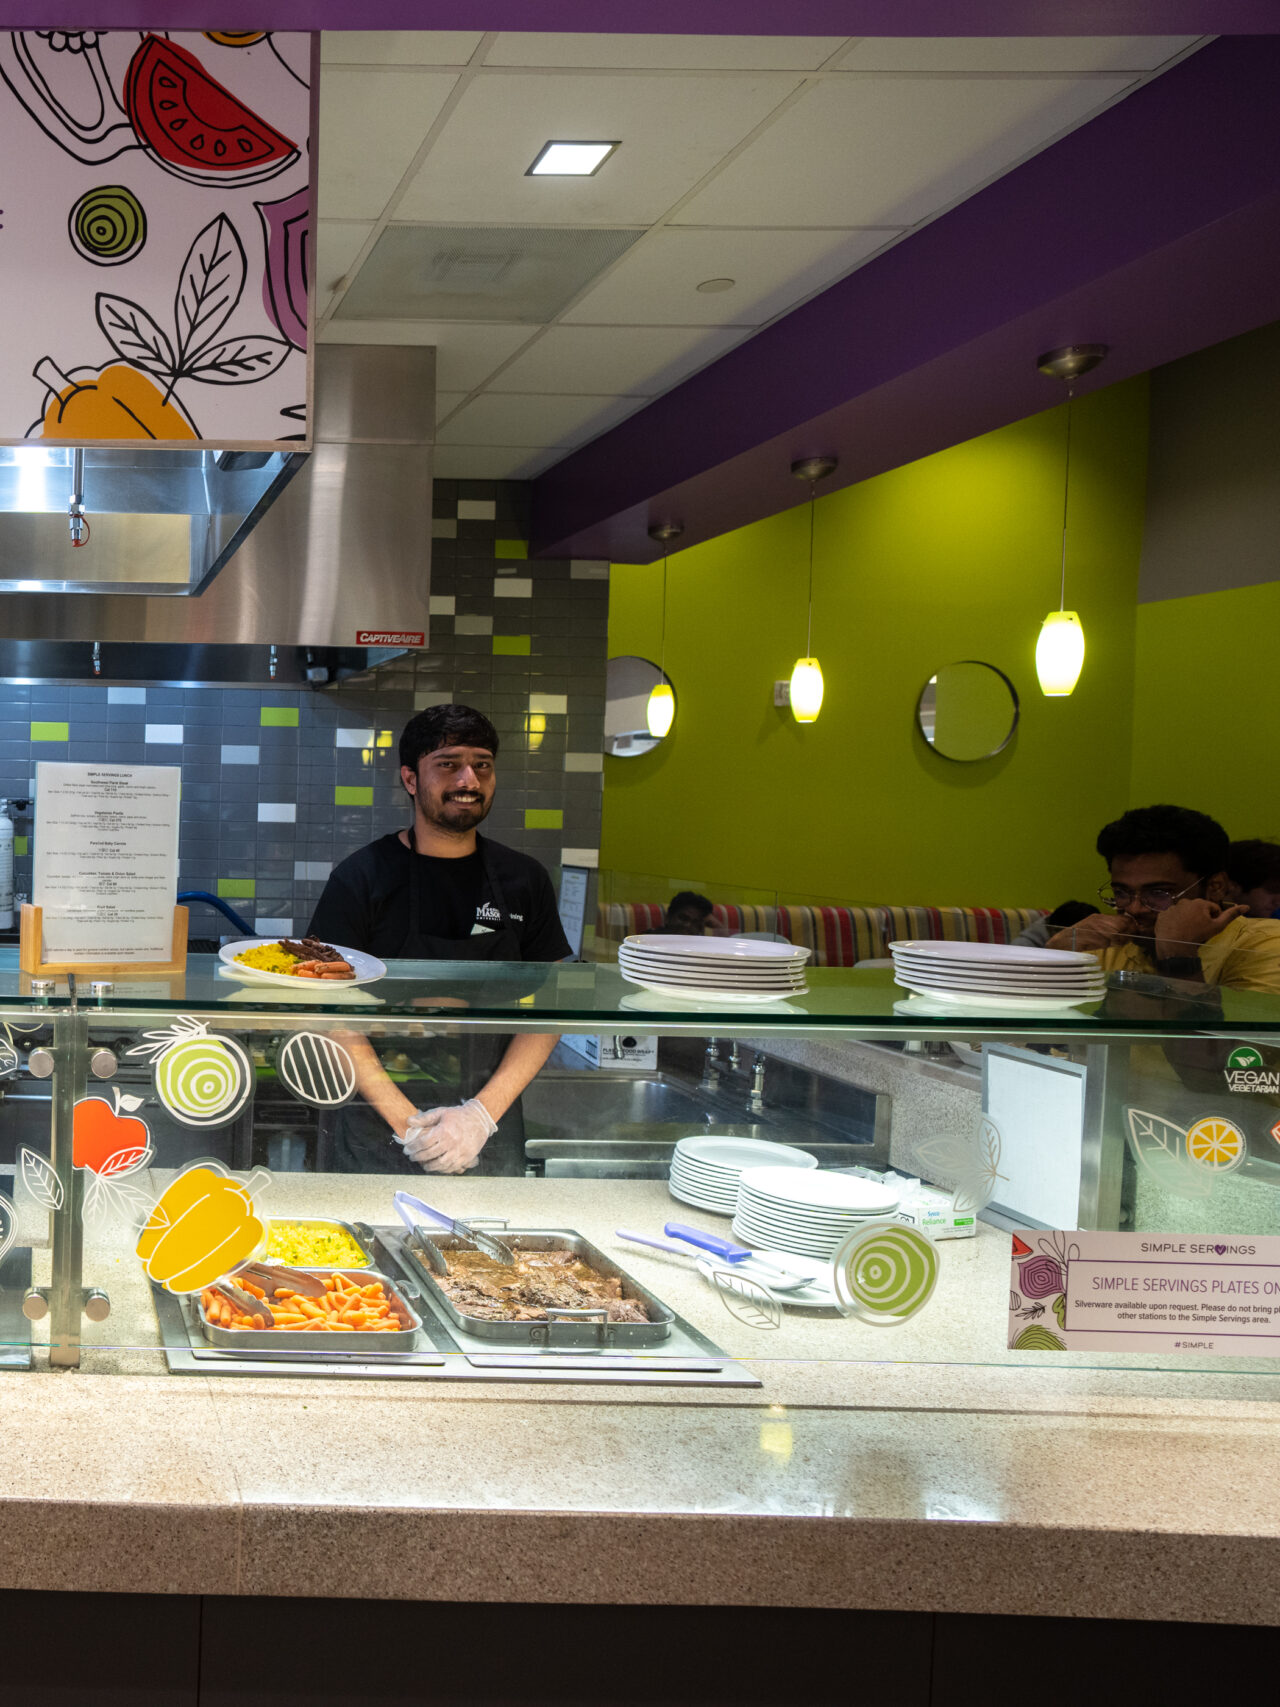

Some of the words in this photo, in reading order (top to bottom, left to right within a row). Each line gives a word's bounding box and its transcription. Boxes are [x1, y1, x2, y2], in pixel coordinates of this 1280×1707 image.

[1224, 1070, 1279, 1085] VEGAN
[1228, 1084, 1279, 1093] VEGETARIAN
[1141, 1243, 1186, 1253] SIMPLE
[1190, 1244, 1256, 1255] SERVINGS
[1092, 1276, 1139, 1291] SIMPLE
[1143, 1278, 1207, 1293] SERVINGS
[1212, 1280, 1259, 1294] PLATES
[1074, 1300, 1113, 1309] Silverware
[1114, 1301, 1147, 1309] available
[1148, 1303, 1167, 1311] upon
[1169, 1303, 1199, 1313] request.
[1201, 1303, 1225, 1312] Please
[1227, 1304, 1237, 1312] do
[1253, 1305, 1272, 1314] bring
[1138, 1312, 1167, 1320] stations
[1178, 1313, 1190, 1321] the
[1192, 1313, 1217, 1323] Simple
[1219, 1314, 1250, 1324] Servings
